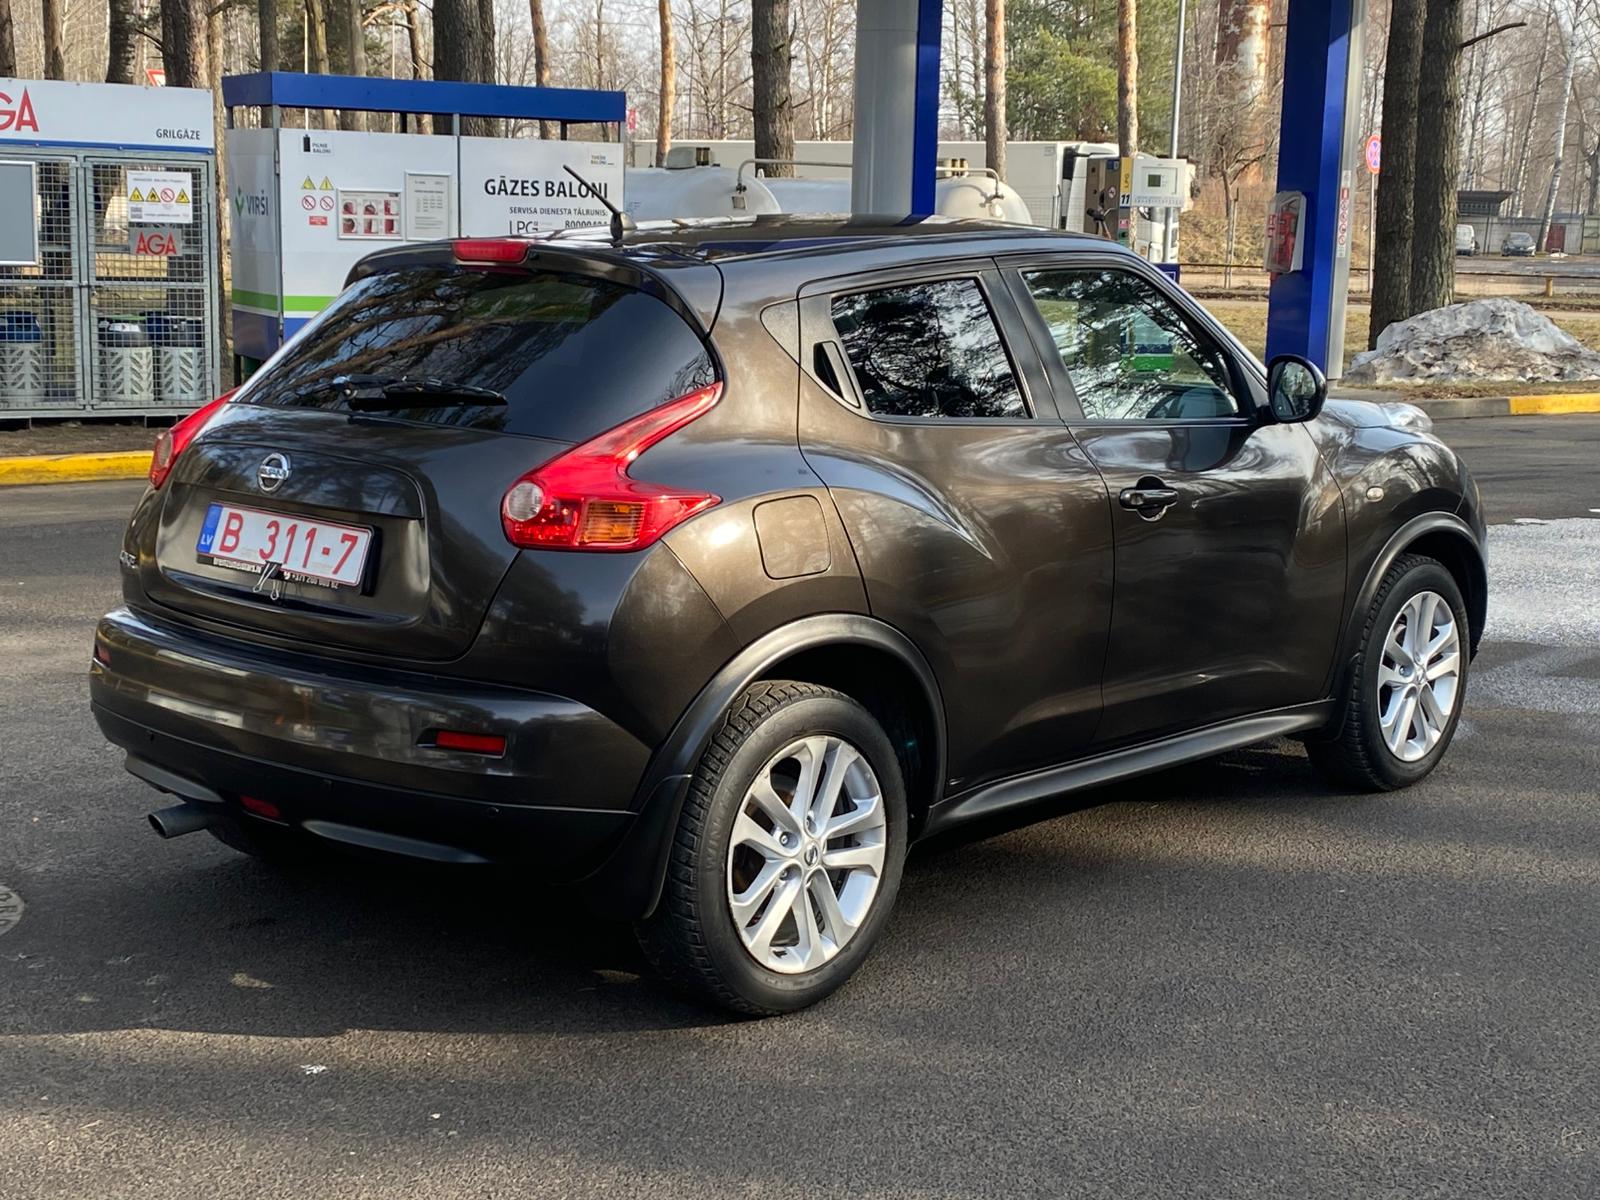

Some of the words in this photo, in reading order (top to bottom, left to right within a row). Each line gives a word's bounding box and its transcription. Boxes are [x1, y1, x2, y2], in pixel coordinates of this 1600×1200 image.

[156, 128, 200, 140] GRILGĀZE
[484, 175, 539, 197] GĀZES
[246, 189, 269, 216] VIRŠI
[1121, 194, 1130, 204] 11
[510, 206, 538, 214] SERVISA
[540, 207, 571, 215] DIENESTA
[573, 207, 608, 216] TĀLRUNIS:
[136, 231, 177, 256] AGA
[201, 533, 213, 545] LV
[219, 511, 244, 553] B
